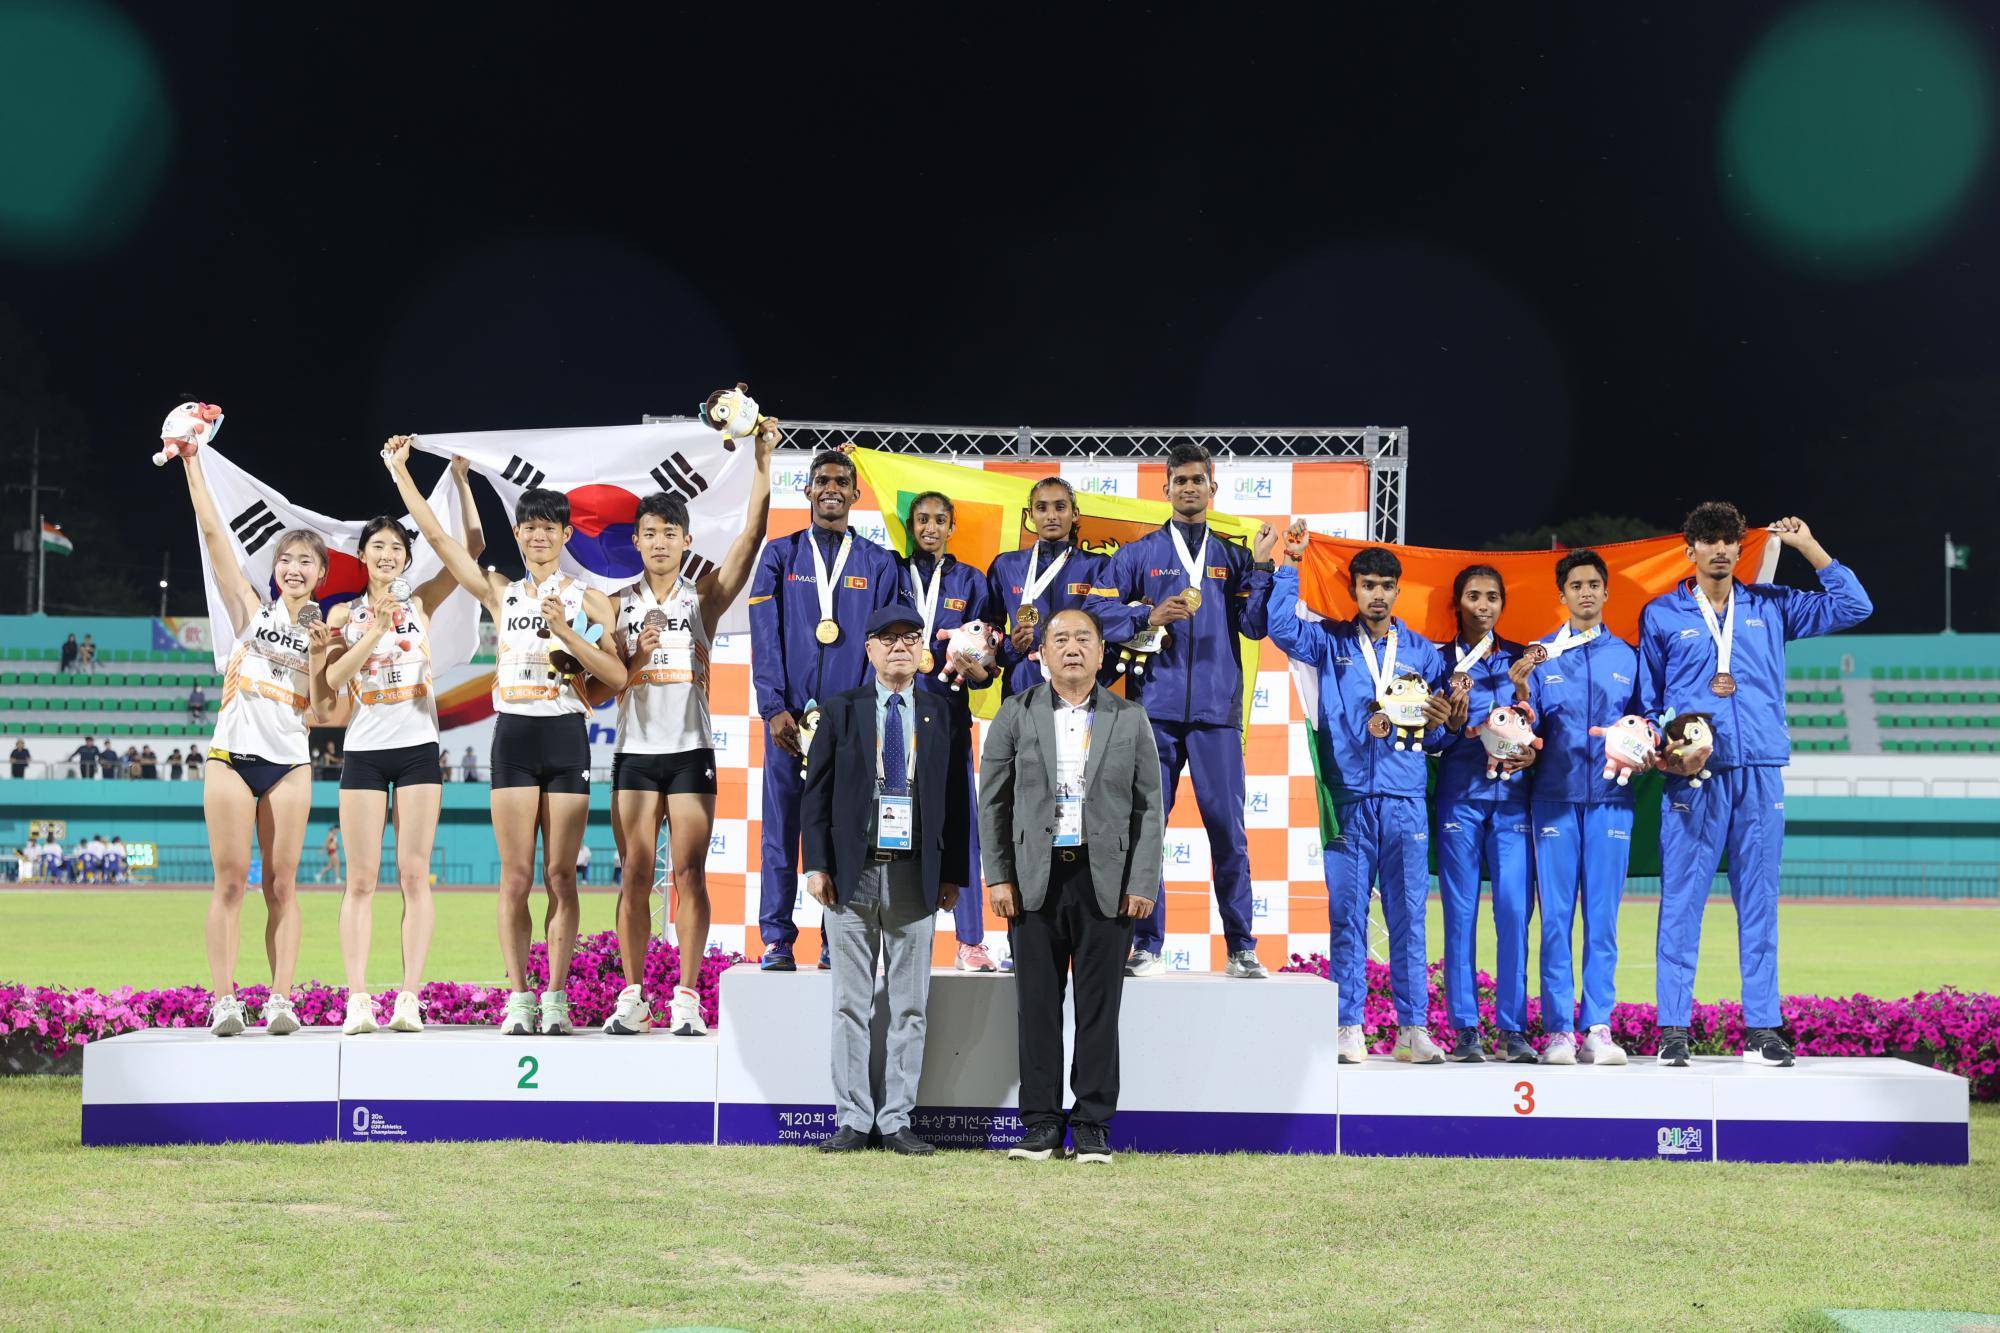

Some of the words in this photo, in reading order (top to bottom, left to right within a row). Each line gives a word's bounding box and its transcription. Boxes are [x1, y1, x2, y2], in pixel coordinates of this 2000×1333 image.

[1234, 477, 1272, 498] 예천
[507, 616, 550, 631] KOR
[387, 671, 402, 684] LEE
[518, 1056, 538, 1088] 2
[1514, 1081, 1535, 1115] 3
[780, 1112, 824, 1127] 제20회
[778, 1130, 800, 1139] 20th
[986, 1133, 1022, 1143] Yecheo
[1657, 1127, 1702, 1152] 예천
